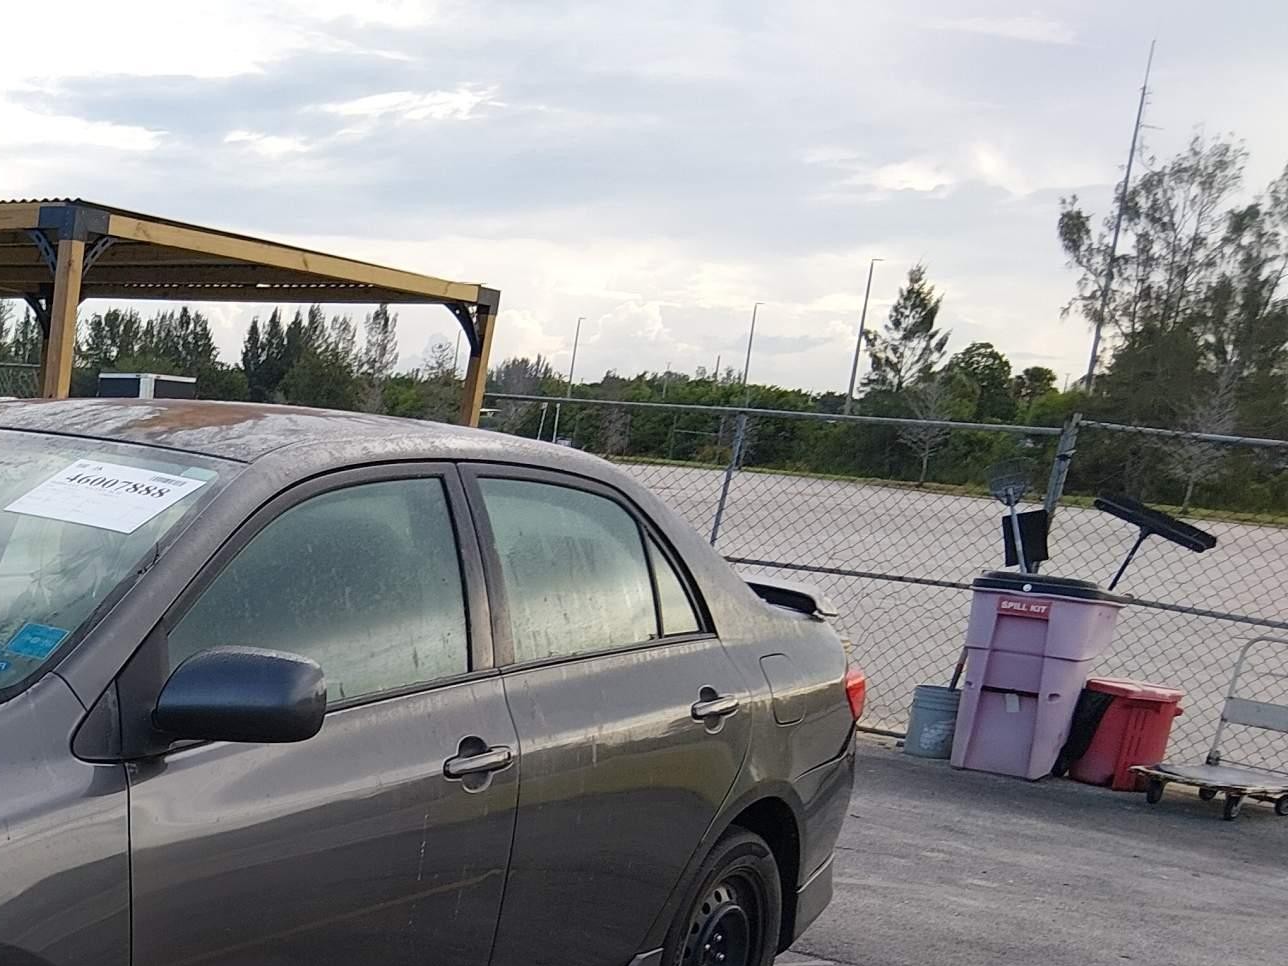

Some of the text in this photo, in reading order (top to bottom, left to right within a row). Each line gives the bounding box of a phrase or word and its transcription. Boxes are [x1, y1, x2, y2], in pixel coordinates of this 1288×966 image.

[66, 473, 171, 498] 46007888
[1001, 600, 1048, 613] SPILL KIT
